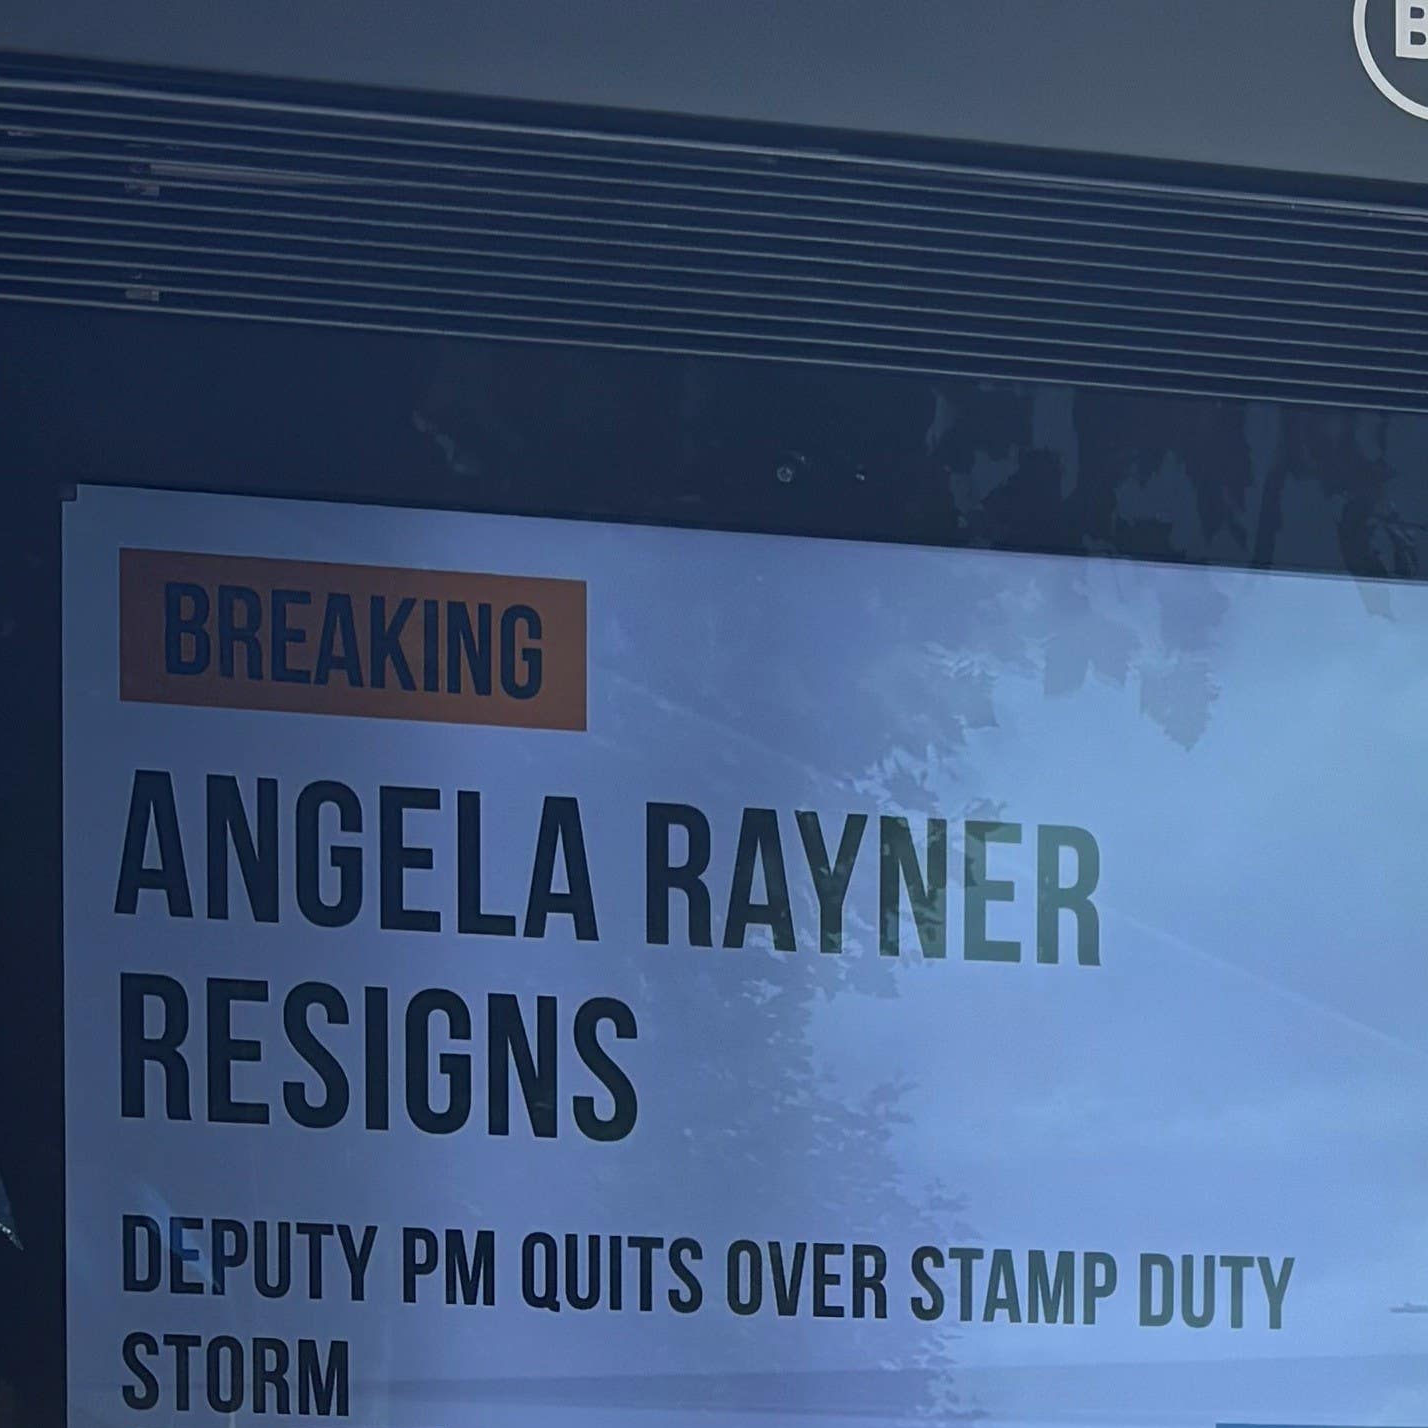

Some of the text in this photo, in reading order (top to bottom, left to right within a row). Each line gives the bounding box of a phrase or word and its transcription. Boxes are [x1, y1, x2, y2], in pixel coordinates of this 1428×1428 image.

[164, 582, 544, 700] BREAKING
[115, 769, 1103, 968] ANGELA RAYNER
[120, 972, 640, 1143] RESIGNS
[122, 1213, 1295, 1331] DEPUTY PM QUITS OVER STAMP DUTY
[122, 1329, 351, 1418] STORM
